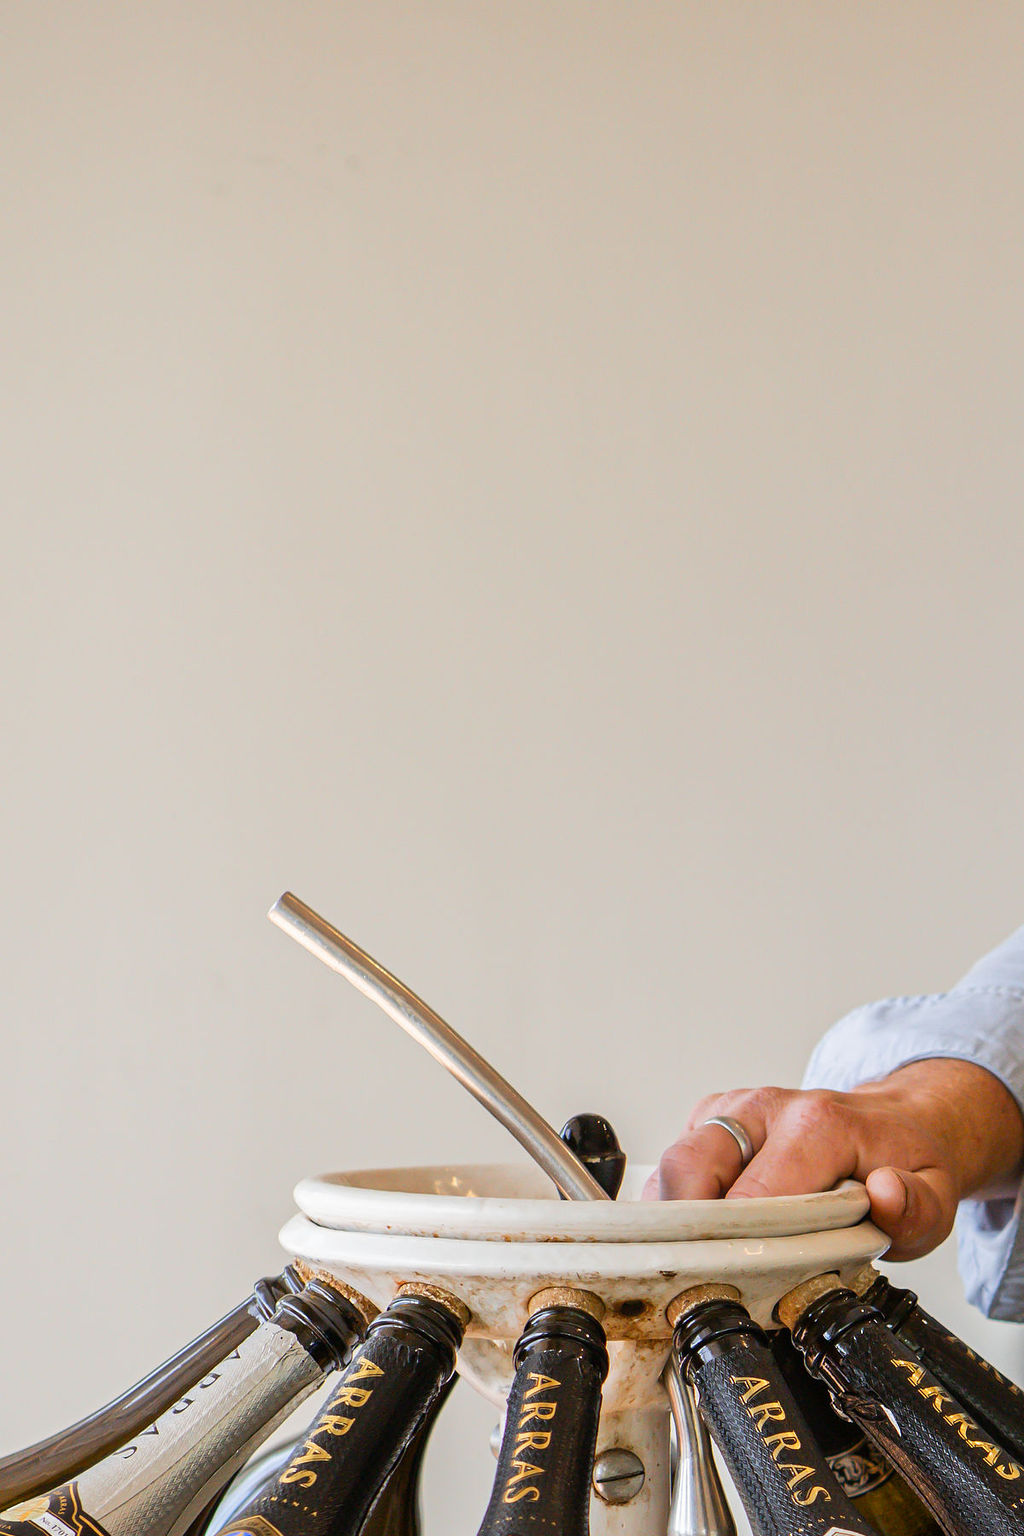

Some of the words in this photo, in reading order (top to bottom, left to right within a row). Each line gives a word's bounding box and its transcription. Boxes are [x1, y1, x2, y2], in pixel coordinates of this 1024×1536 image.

[278, 1355, 386, 1489] ARRAS
[502, 1371, 562, 1504] ARRAS
[728, 1374, 832, 1507] ARRAS
